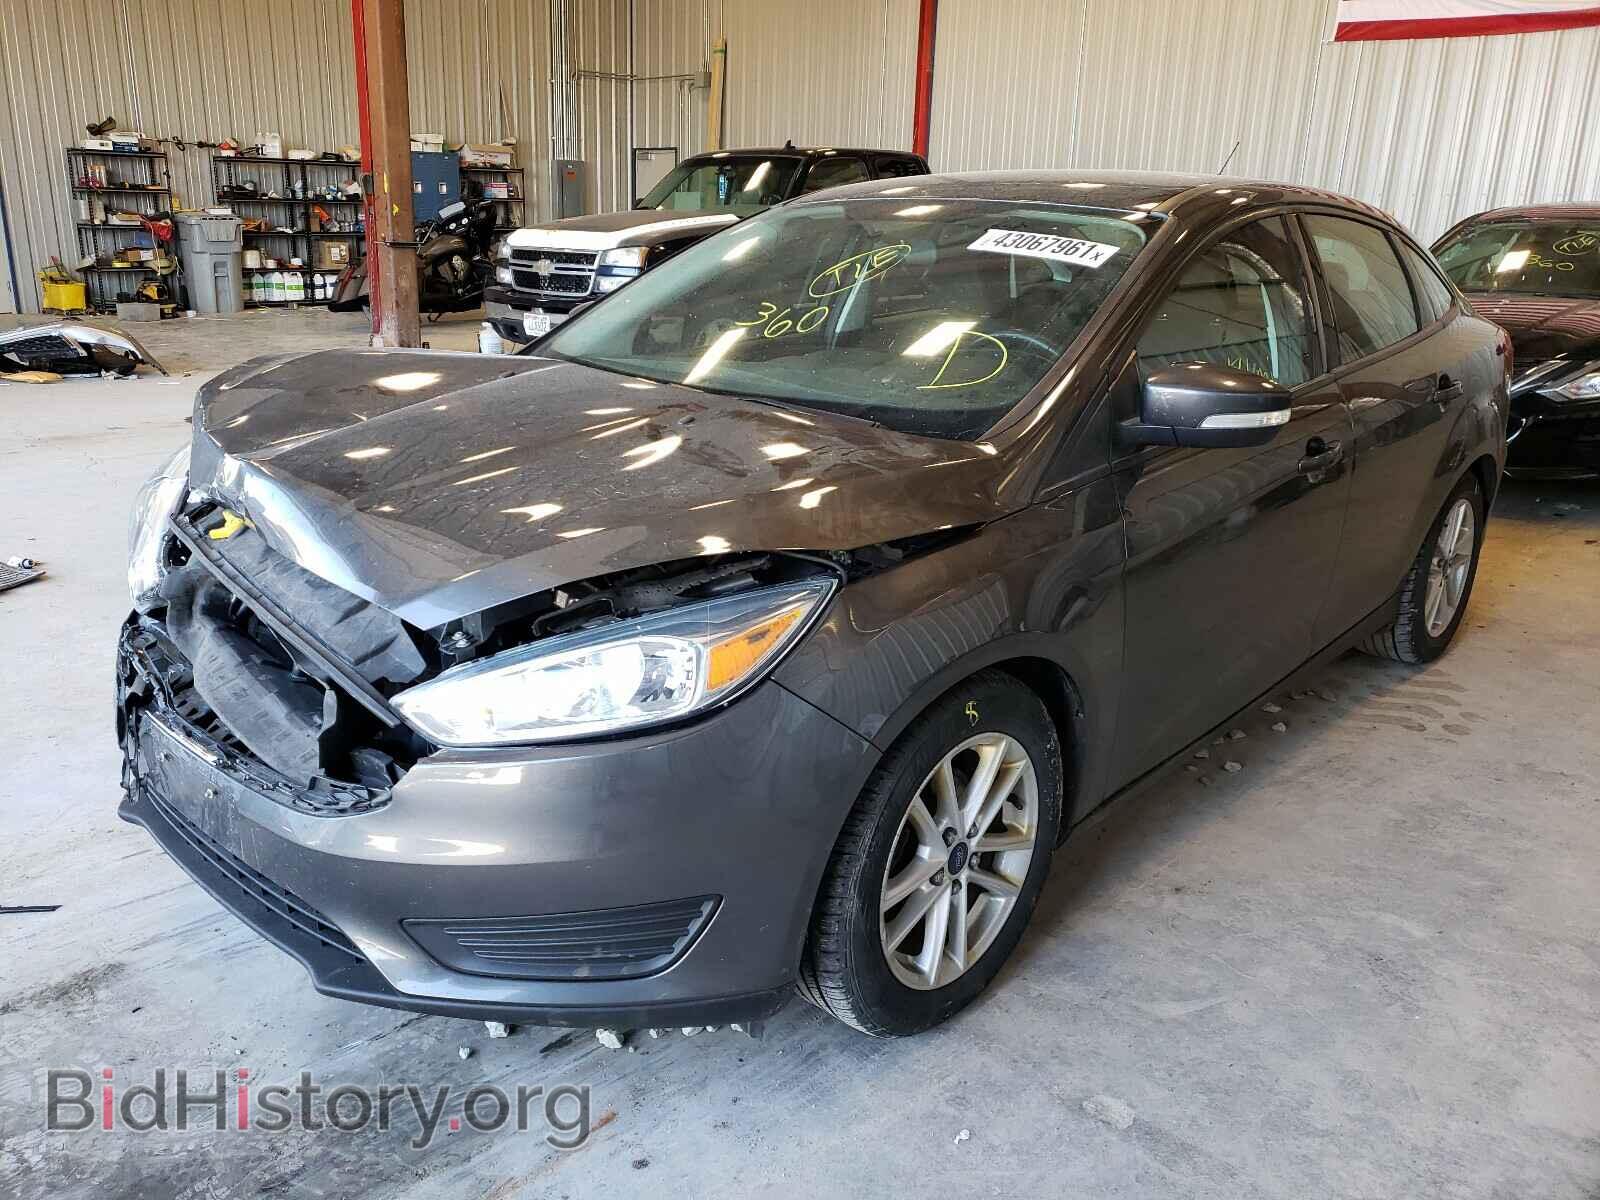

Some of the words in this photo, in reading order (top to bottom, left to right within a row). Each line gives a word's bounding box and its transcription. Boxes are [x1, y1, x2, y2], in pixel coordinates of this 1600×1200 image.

[993, 232, 1098, 259] 43067961
[735, 302, 829, 338] 360
[915, 330, 1008, 389] D
